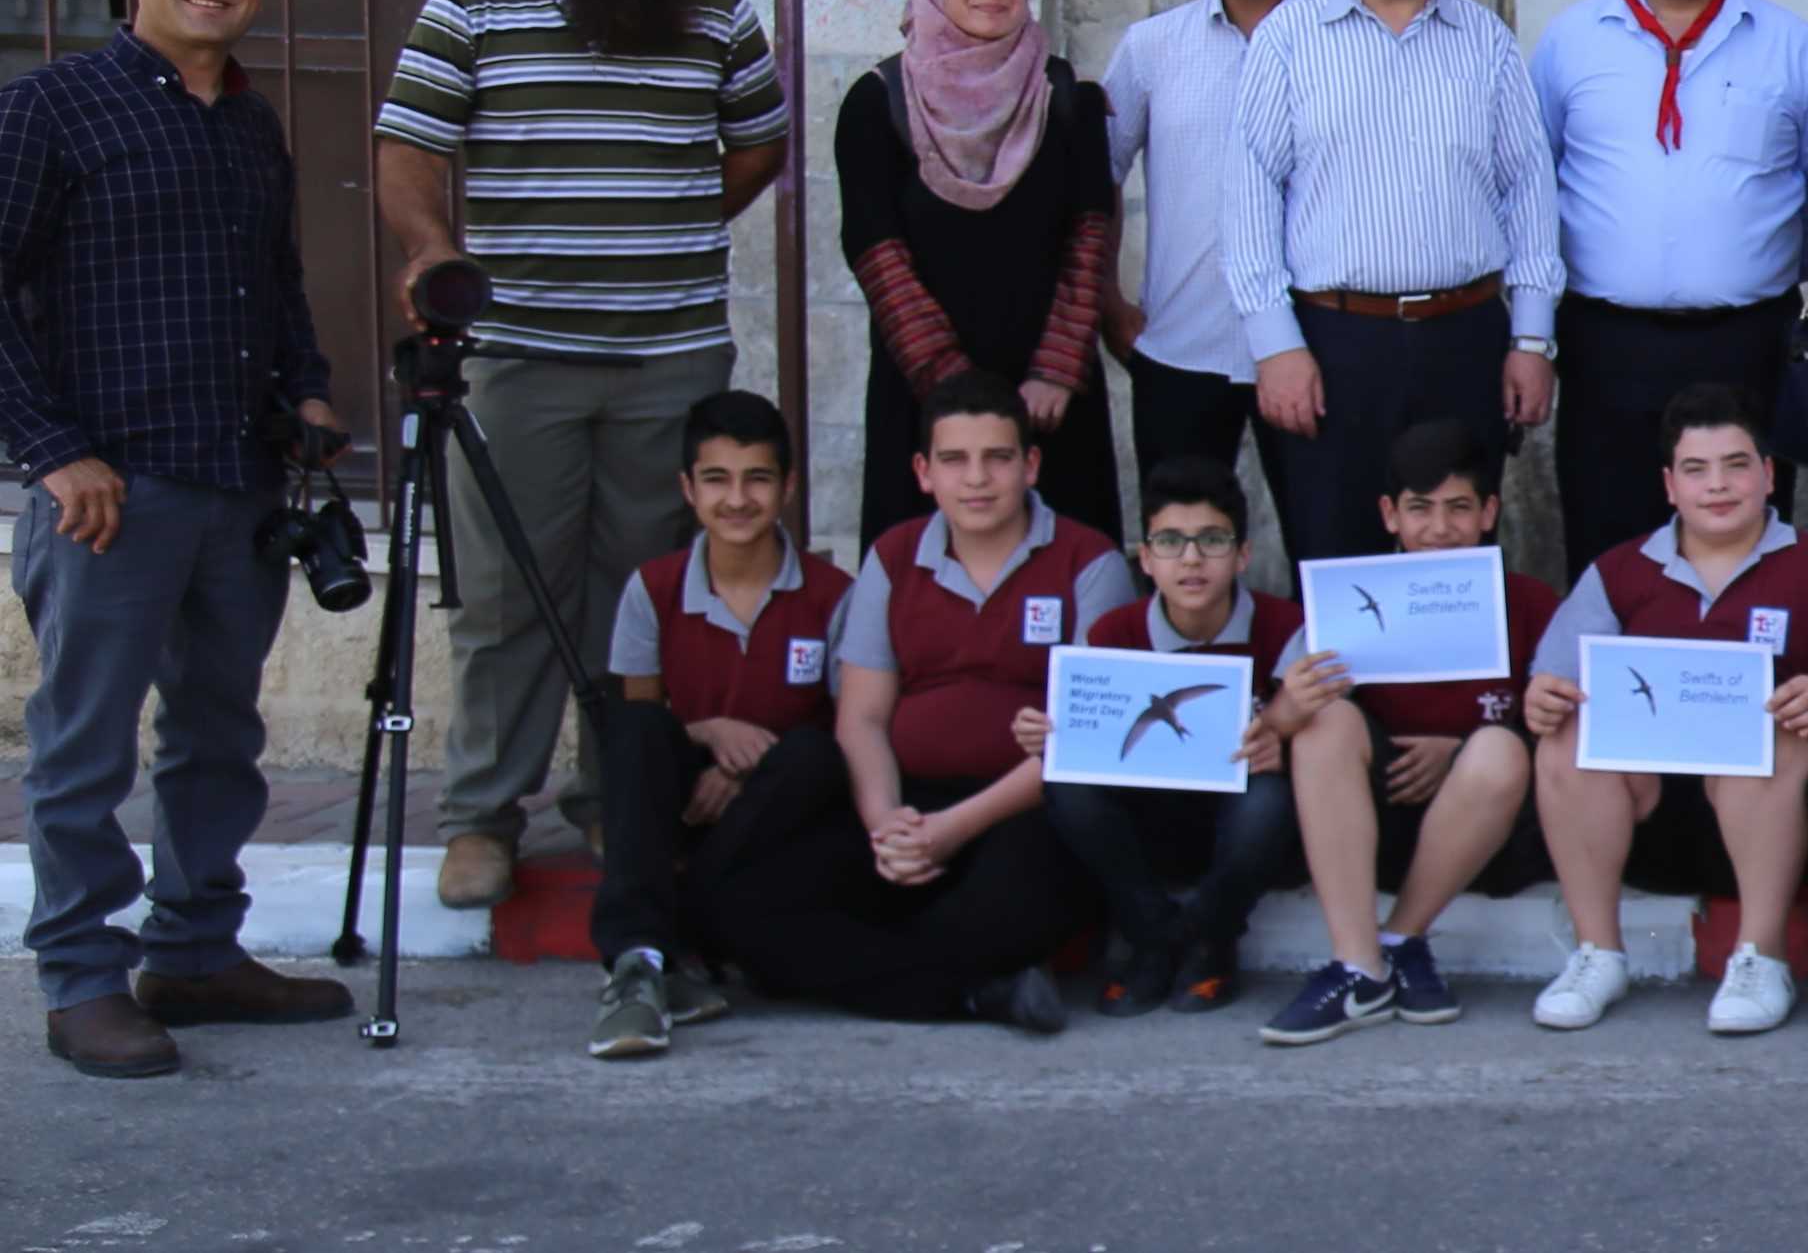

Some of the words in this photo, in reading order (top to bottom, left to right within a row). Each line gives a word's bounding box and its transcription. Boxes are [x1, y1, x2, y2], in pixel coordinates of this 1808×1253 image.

[1407, 581, 1452, 596] Swifts
[1457, 580, 1473, 595] of
[1680, 670, 1722, 686] Swifts
[1728, 671, 1743, 686] of
